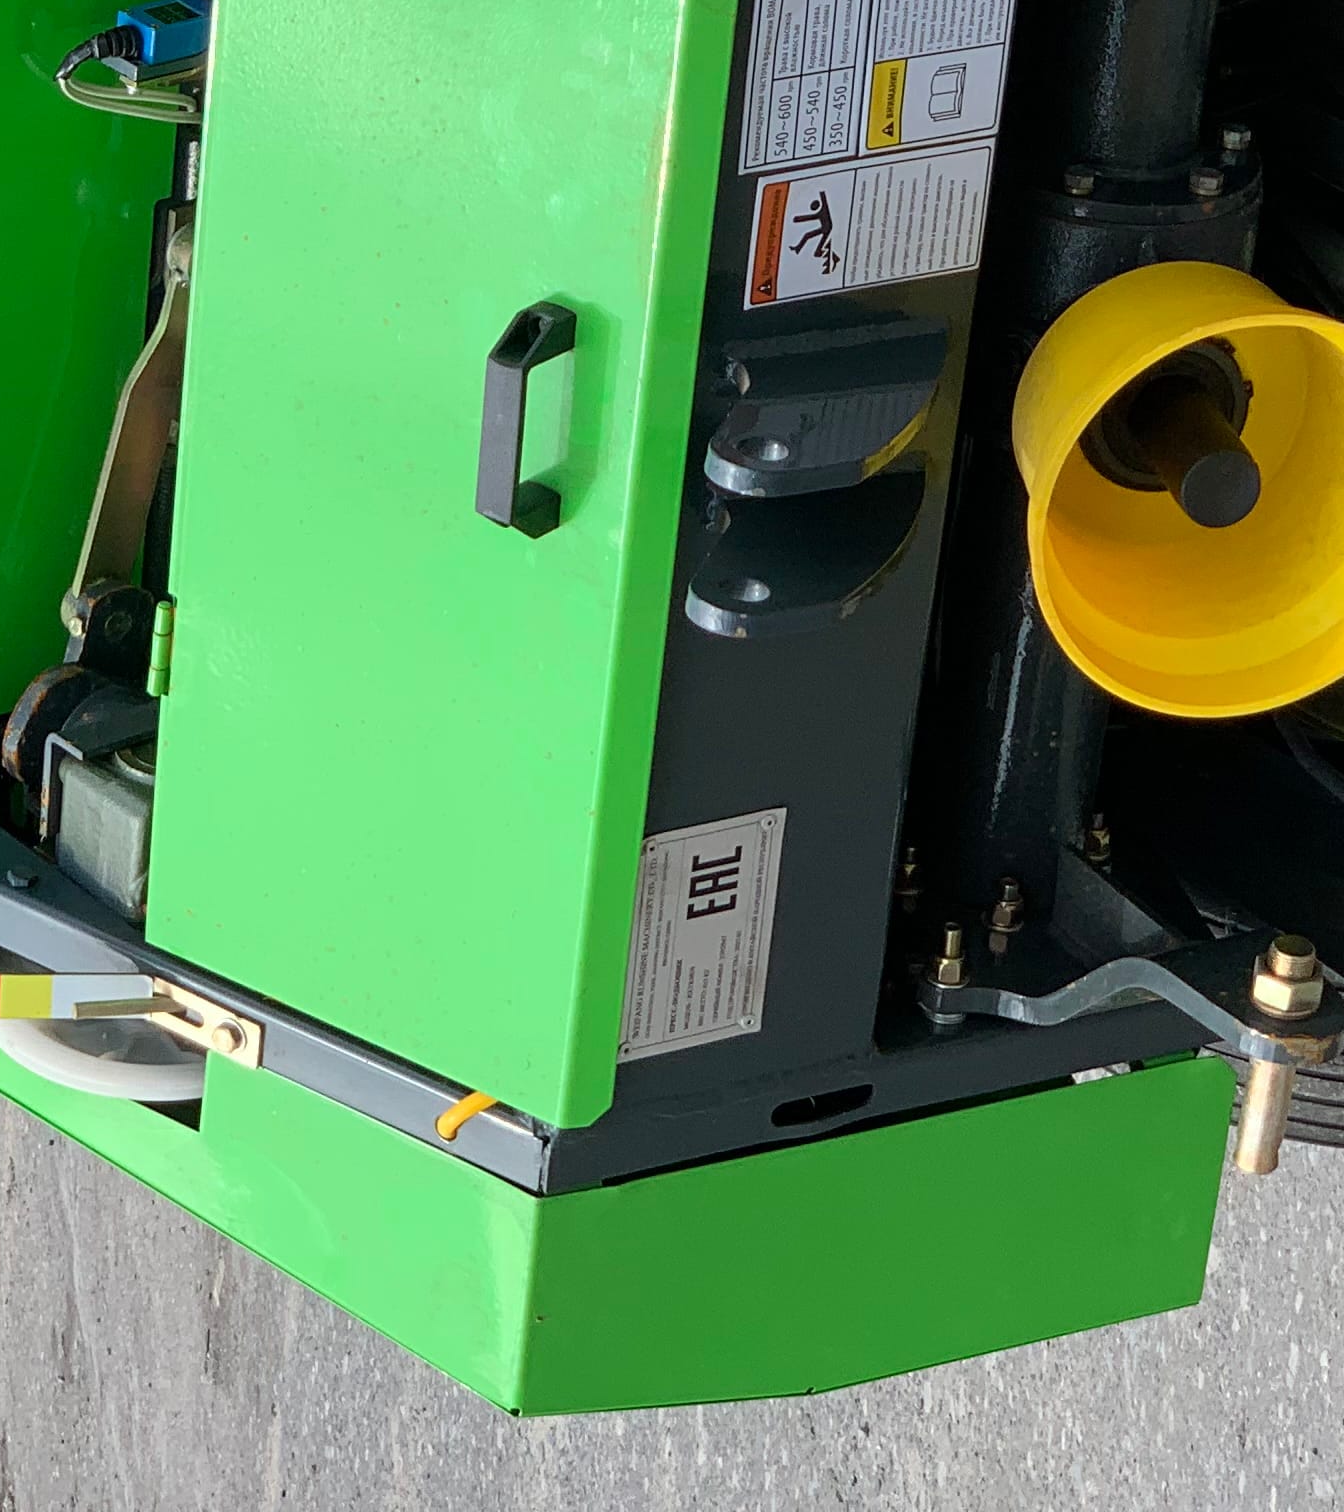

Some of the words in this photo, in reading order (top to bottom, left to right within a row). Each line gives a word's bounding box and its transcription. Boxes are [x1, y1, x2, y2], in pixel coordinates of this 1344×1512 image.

[766, 0, 776, 18] ВОМ
[821, 3, 830, 33] солома
[762, 18, 774, 61] вращения
[781, 11, 792, 46] высокой
[789, 23, 801, 72] влажностью
[839, 27, 851, 64] Короткая
[778, 51, 789, 74] Трава
[807, 29, 820, 69] Кормовая
[818, 33, 828, 68] длинная
[758, 60, 769, 94] частота
[884, 66, 899, 119] ВНИМАНИЕ!
[773, 94, 792, 157] 540~600
[801, 89, 821, 152] 450~540
[828, 85, 847, 147] 350~450
